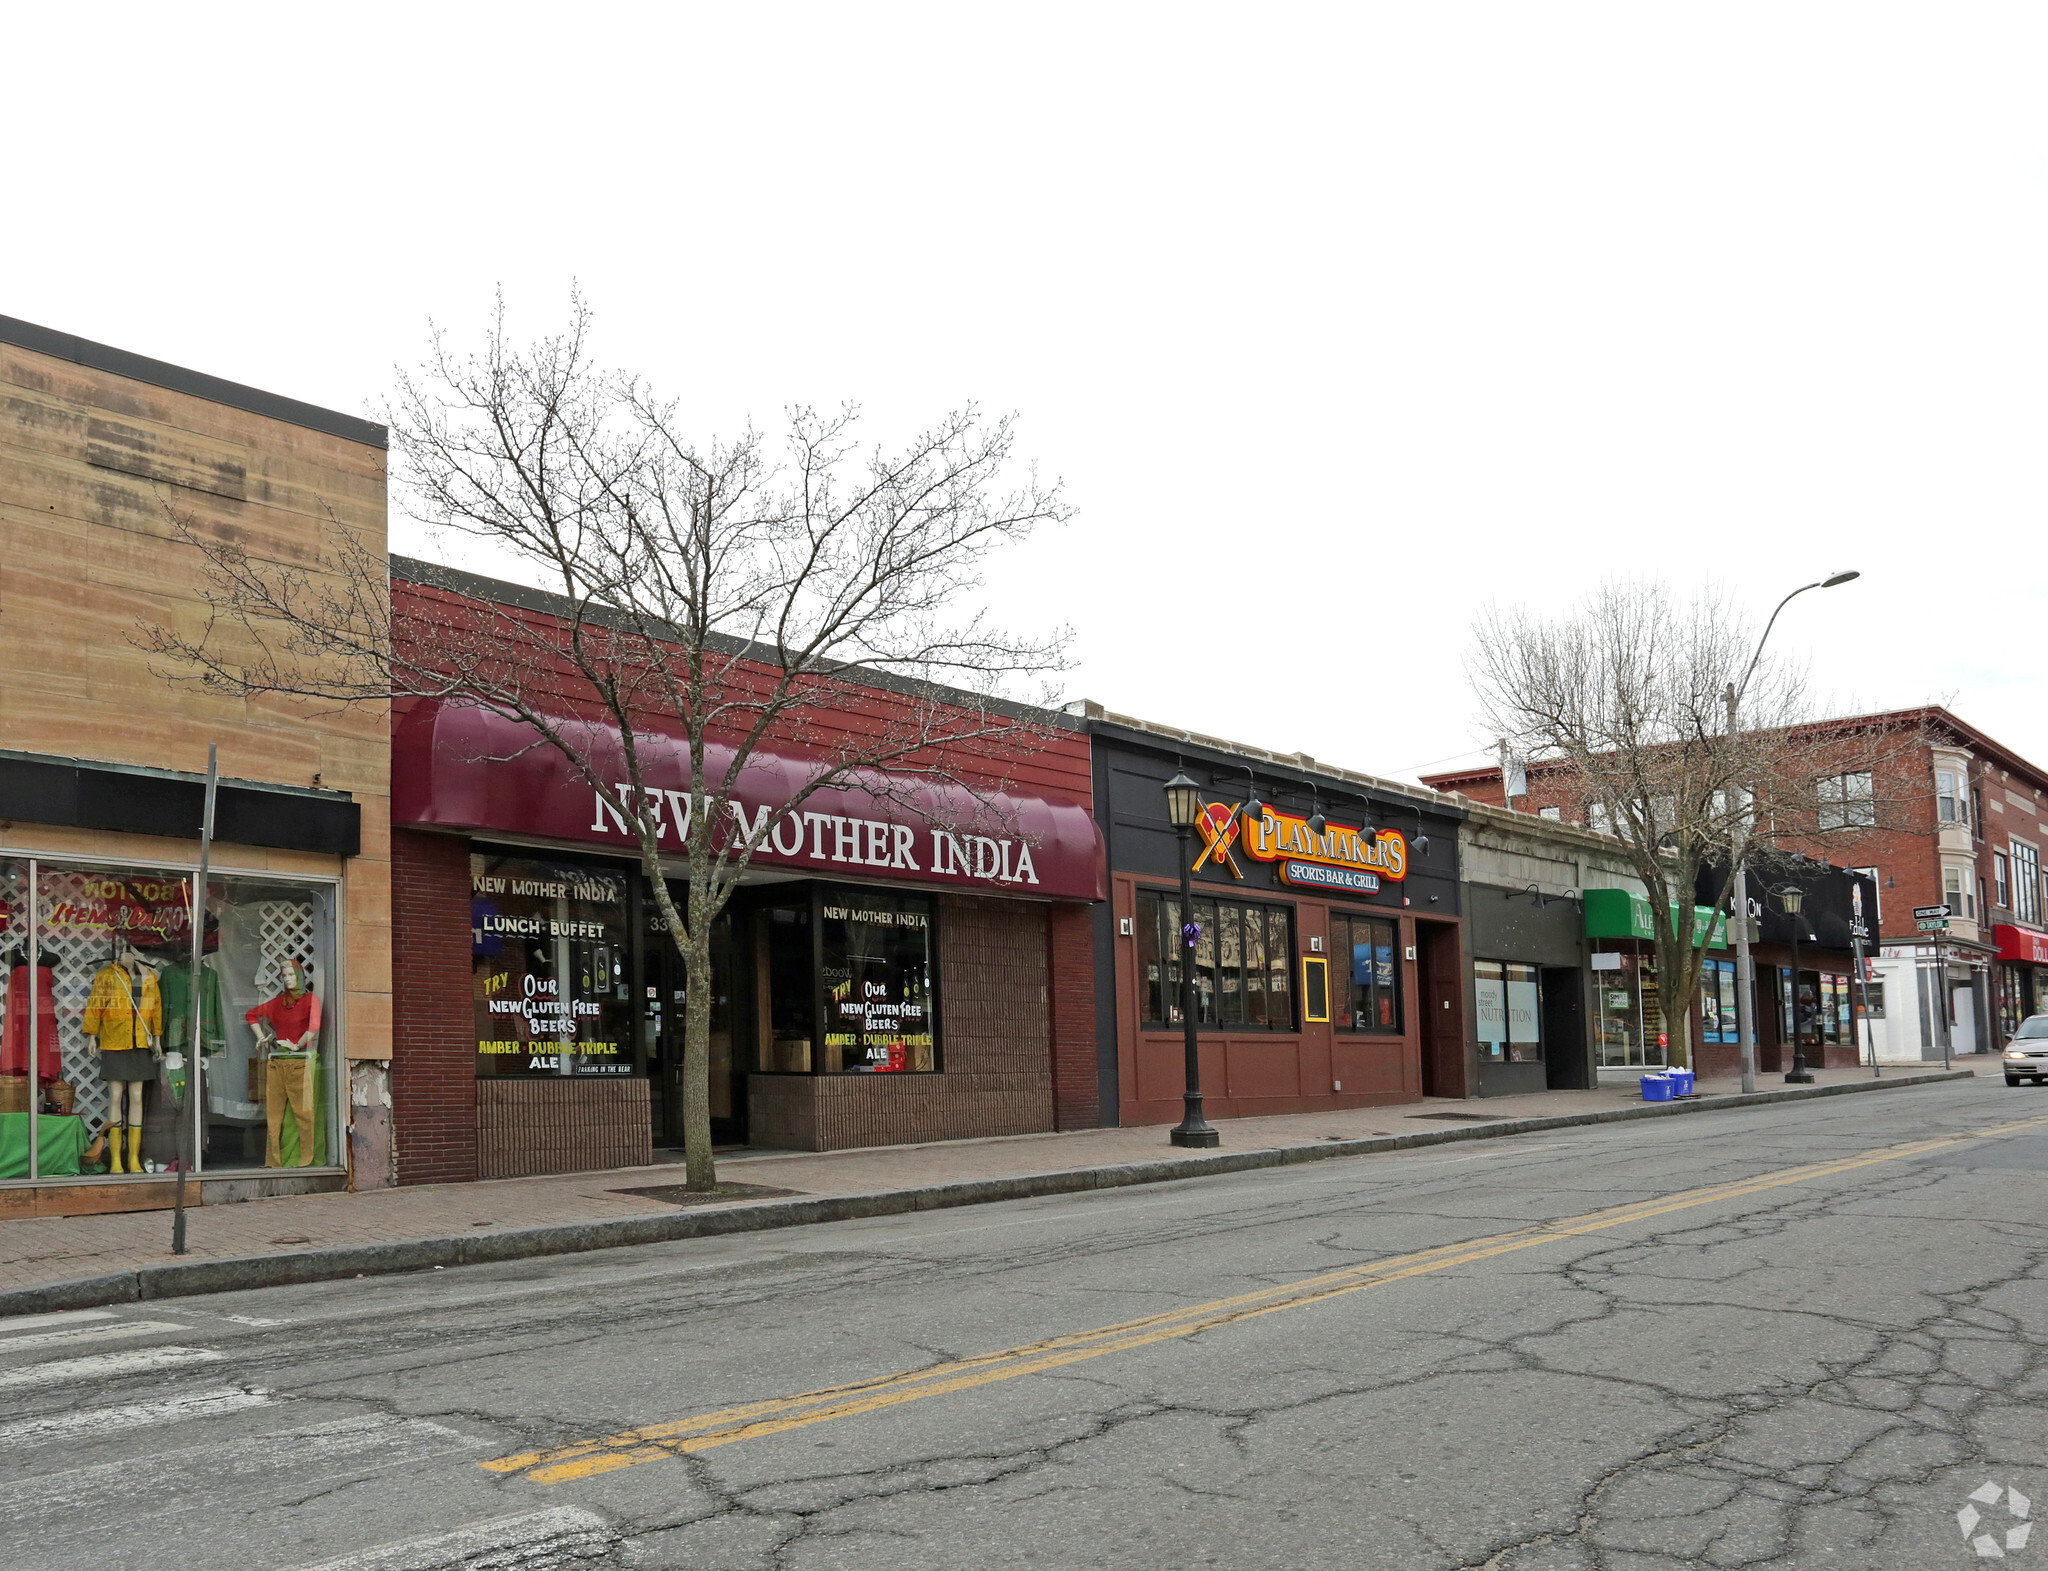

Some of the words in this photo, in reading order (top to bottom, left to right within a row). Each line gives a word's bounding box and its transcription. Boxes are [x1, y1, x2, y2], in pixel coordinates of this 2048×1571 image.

[590, 780, 715, 842] NEW
[729, 799, 920, 871] MOTHER
[930, 829, 1039, 885] INDIA
[1257, 814, 1403, 873] PLAYMAKERS
[1290, 864, 1325, 882] SPORTS
[1326, 869, 1344, 884] BAR
[1345, 875, 1353, 886] &
[1353, 875, 1379, 890] GRILL
[473, 876, 506, 894] NEW
[512, 879, 566, 898] MOTHER
[573, 885, 616, 903] INDIA
[823, 906, 848, 920] NEW
[851, 909, 893, 924] MOTHER
[896, 913, 928, 928] INDIA
[1926, 920, 1944, 930] TAYLOR
[483, 916, 540, 934] LUNCH
[550, 921, 605, 938] BUFFET
[483, 972, 509, 996] TRY
[523, 973, 559, 997] OUR
[833, 980, 851, 1001] TRY
[864, 981, 887, 998] OUR
[1478, 999, 1494, 1008] street
[1480, 989, 1498, 1002] moody
[489, 1000, 522, 1013] NEW
[522, 998, 569, 1019] GLUTEN
[571, 999, 600, 1018] FREE
[840, 1003, 864, 1014] NEW
[864, 1001, 899, 1019] GLUTEN
[900, 1001, 922, 1018] FREE
[1480, 1007, 1531, 1023] NUTRTION
[529, 1018, 577, 1034] BEERS
[865, 1018, 899, 1031] BEERS
[478, 1040, 521, 1055] AMBER
[528, 1041, 577, 1055] DUBBLE
[578, 1041, 618, 1055] TRIPLE
[824, 1033, 857, 1046] AMBER
[863, 1034, 899, 1046] DUBBLE
[900, 1034, 933, 1046] TRIPLE
[866, 1048, 888, 1060] ALE
[529, 1056, 559, 1070] ALE
[600, 1065, 606, 1073] IN
[607, 1065, 617, 1073] THE
[618, 1065, 631, 1073] REAR
